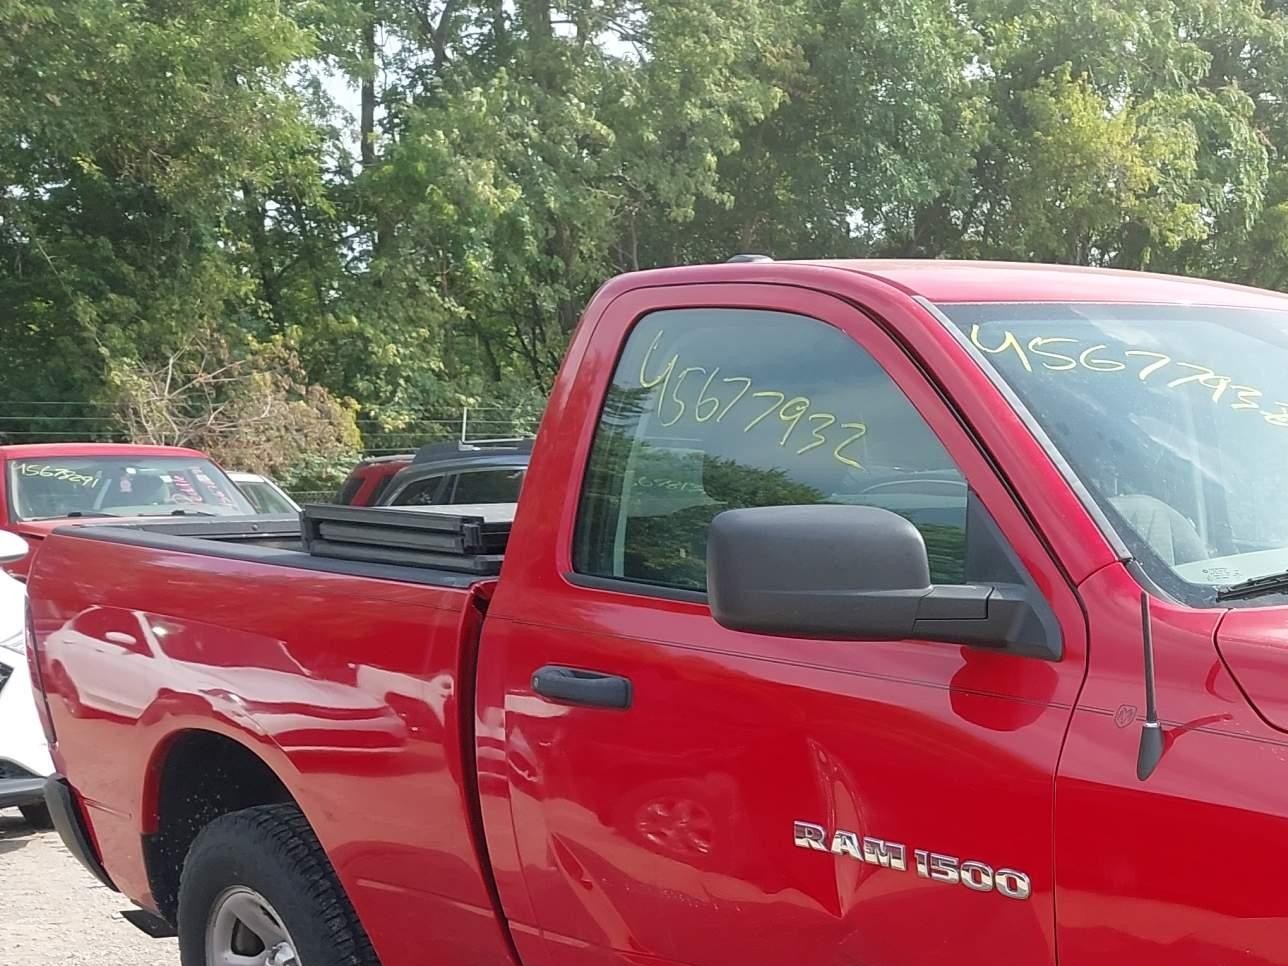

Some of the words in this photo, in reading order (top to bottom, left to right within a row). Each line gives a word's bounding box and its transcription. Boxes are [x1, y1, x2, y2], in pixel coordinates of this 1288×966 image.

[640, 329, 866, 471] 45677932
[793, 820, 908, 872] RAM
[914, 848, 1032, 900] 1500
